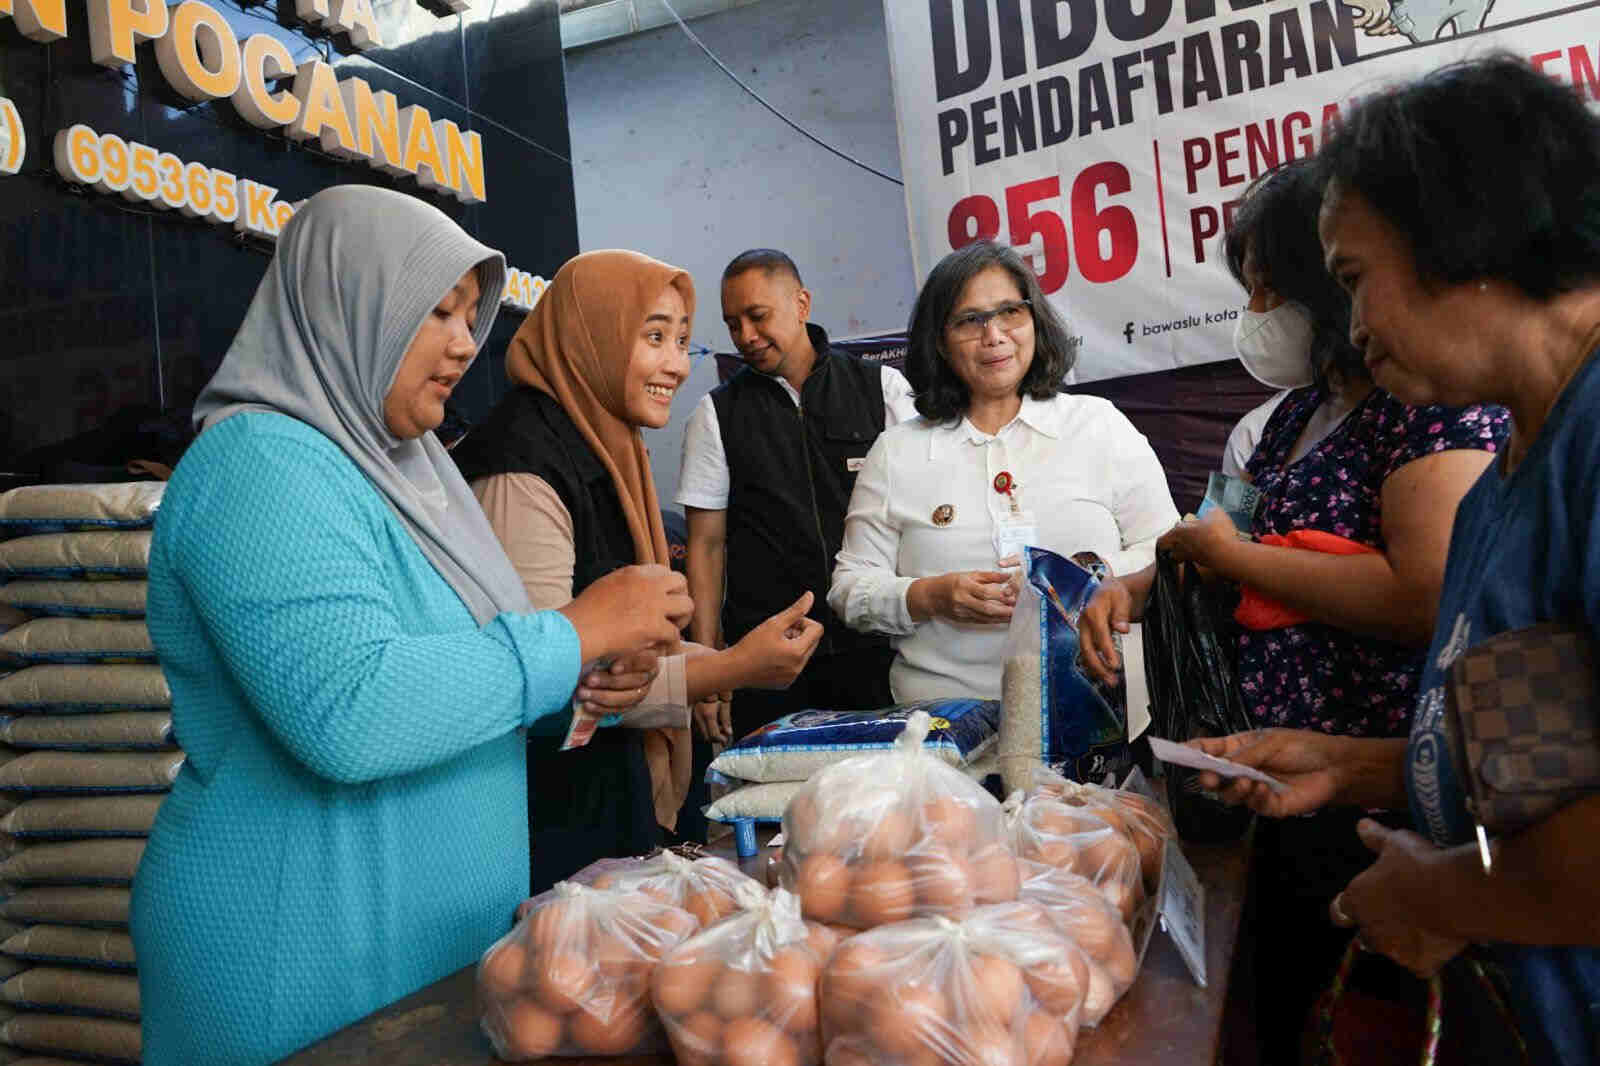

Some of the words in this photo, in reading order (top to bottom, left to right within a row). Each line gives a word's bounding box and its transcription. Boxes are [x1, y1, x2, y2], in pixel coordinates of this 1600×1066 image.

[92, 0, 487, 202] POCANAN
[937, 0, 1359, 176] PENDAFTARAN
[58, 123, 239, 222] 695365
[1143, 314, 1201, 337] bawaslu
[1205, 309, 1239, 326] kota
